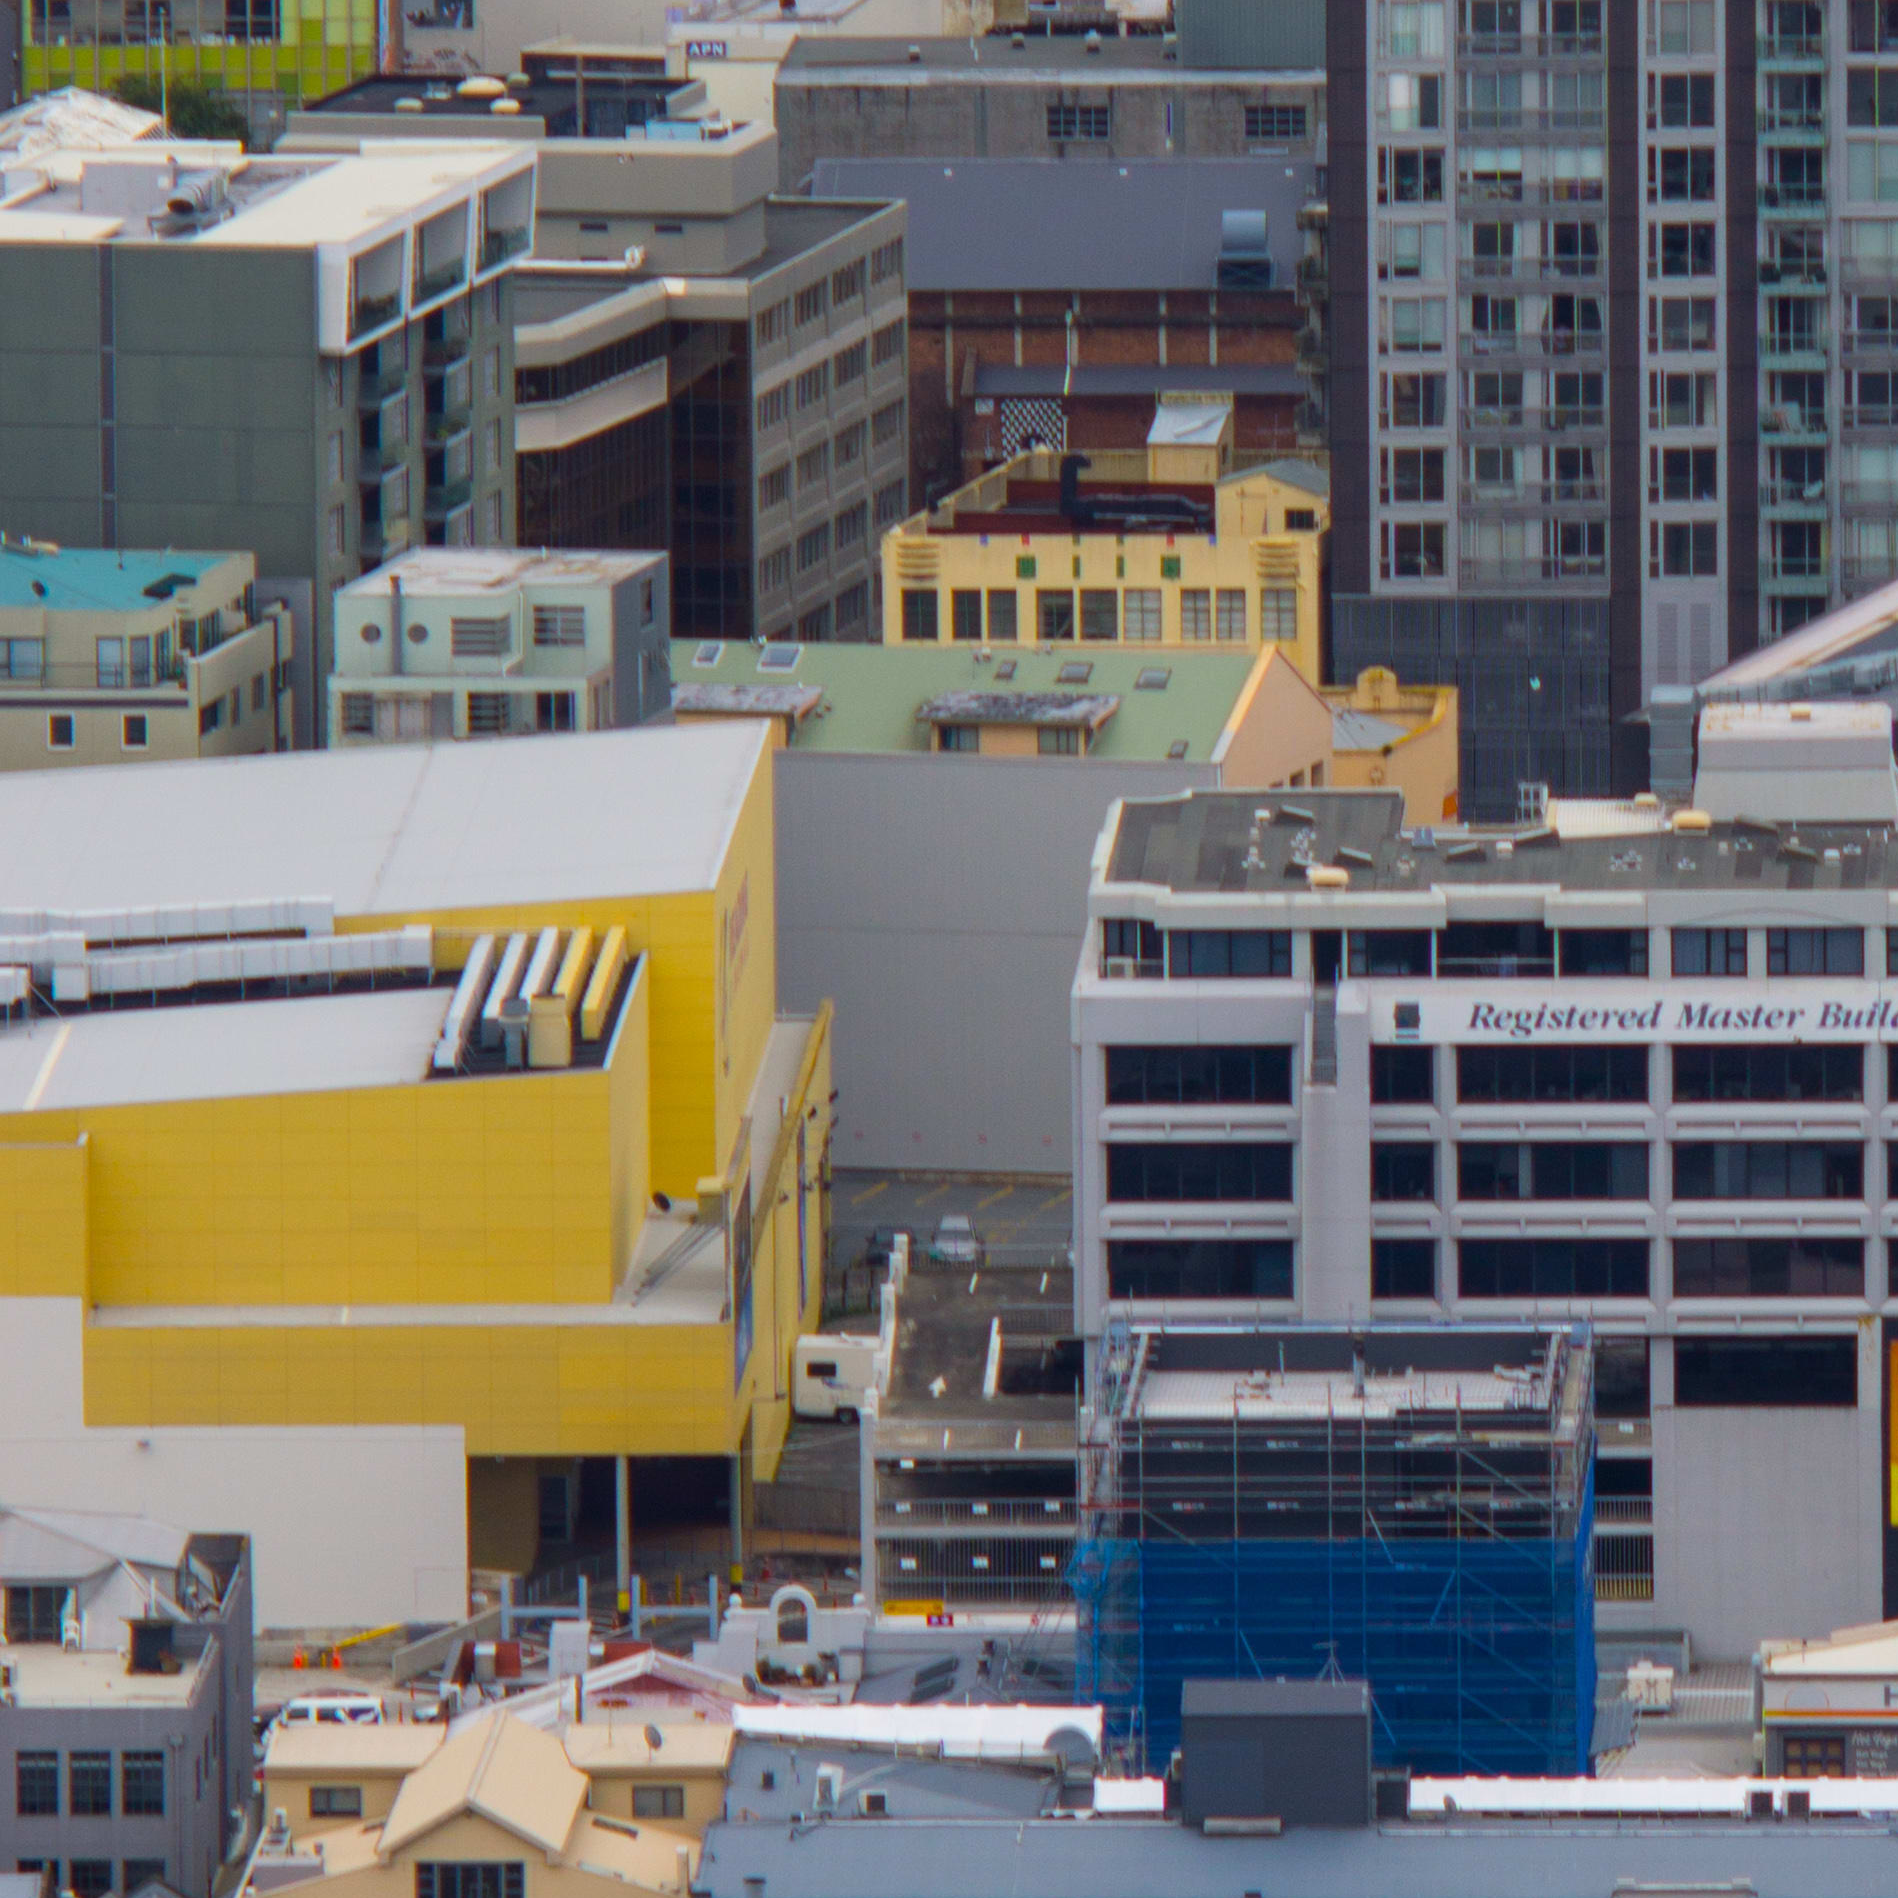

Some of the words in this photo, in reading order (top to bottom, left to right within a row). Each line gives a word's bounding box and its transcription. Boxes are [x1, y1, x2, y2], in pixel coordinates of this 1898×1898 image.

[689, 41, 723, 56] APN
[1467, 1000, 1664, 1038] Registered
[1675, 1001, 1805, 1031] Master
